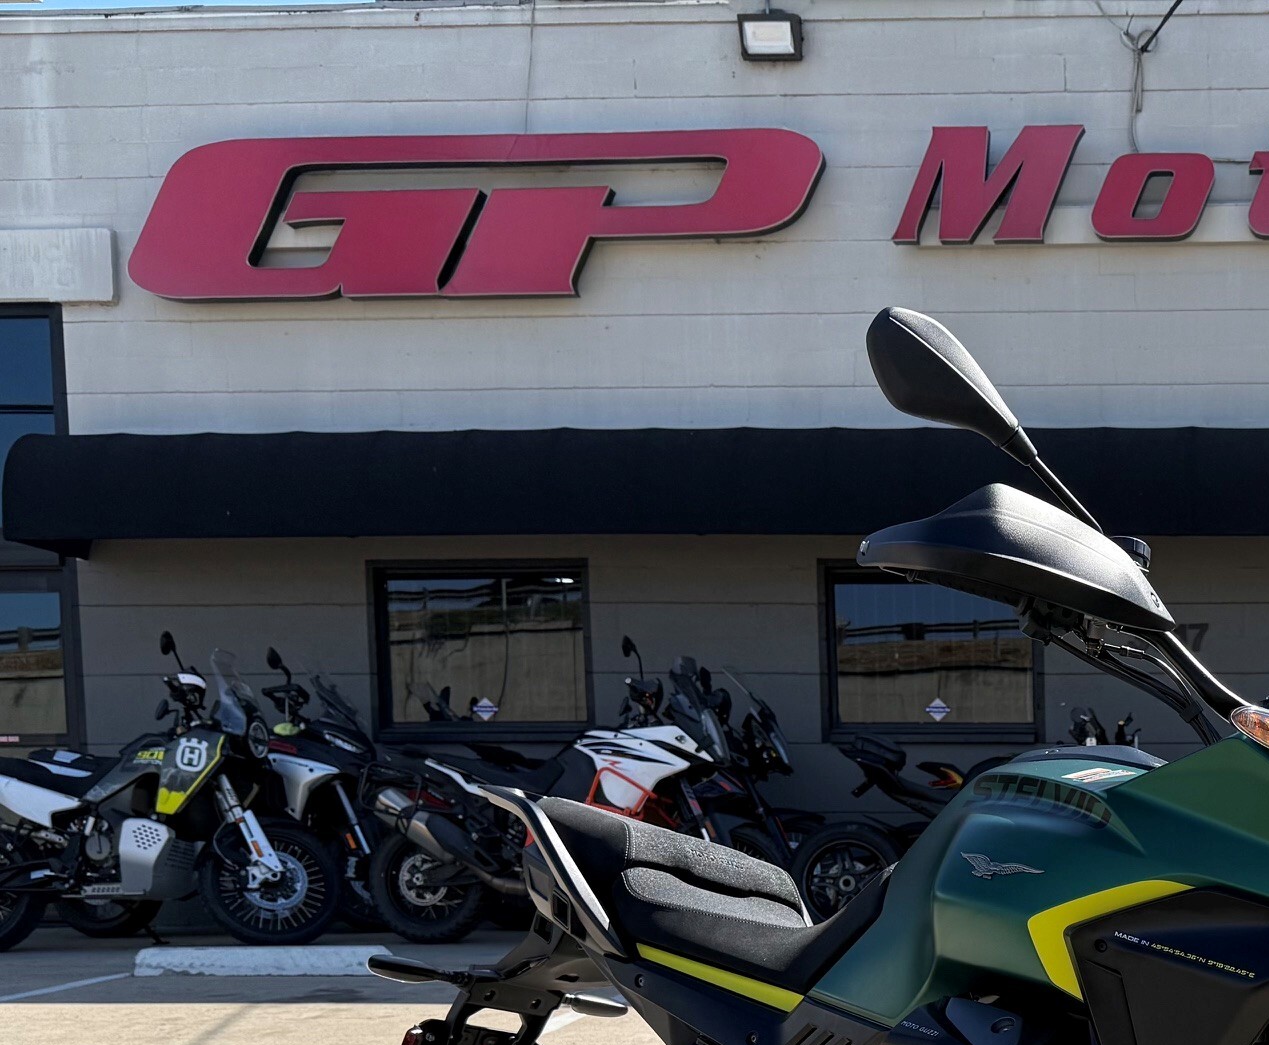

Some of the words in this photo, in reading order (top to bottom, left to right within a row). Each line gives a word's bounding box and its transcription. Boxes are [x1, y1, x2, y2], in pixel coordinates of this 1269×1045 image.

[127, 127, 824, 300] GP
[966, 774, 1112, 829] STELVIO
[1114, 931, 1140, 944] MADE
[1140, 939, 1150, 947] IN
[900, 1020, 920, 1030] MOTO
[919, 1026, 940, 1037] GUZZI
